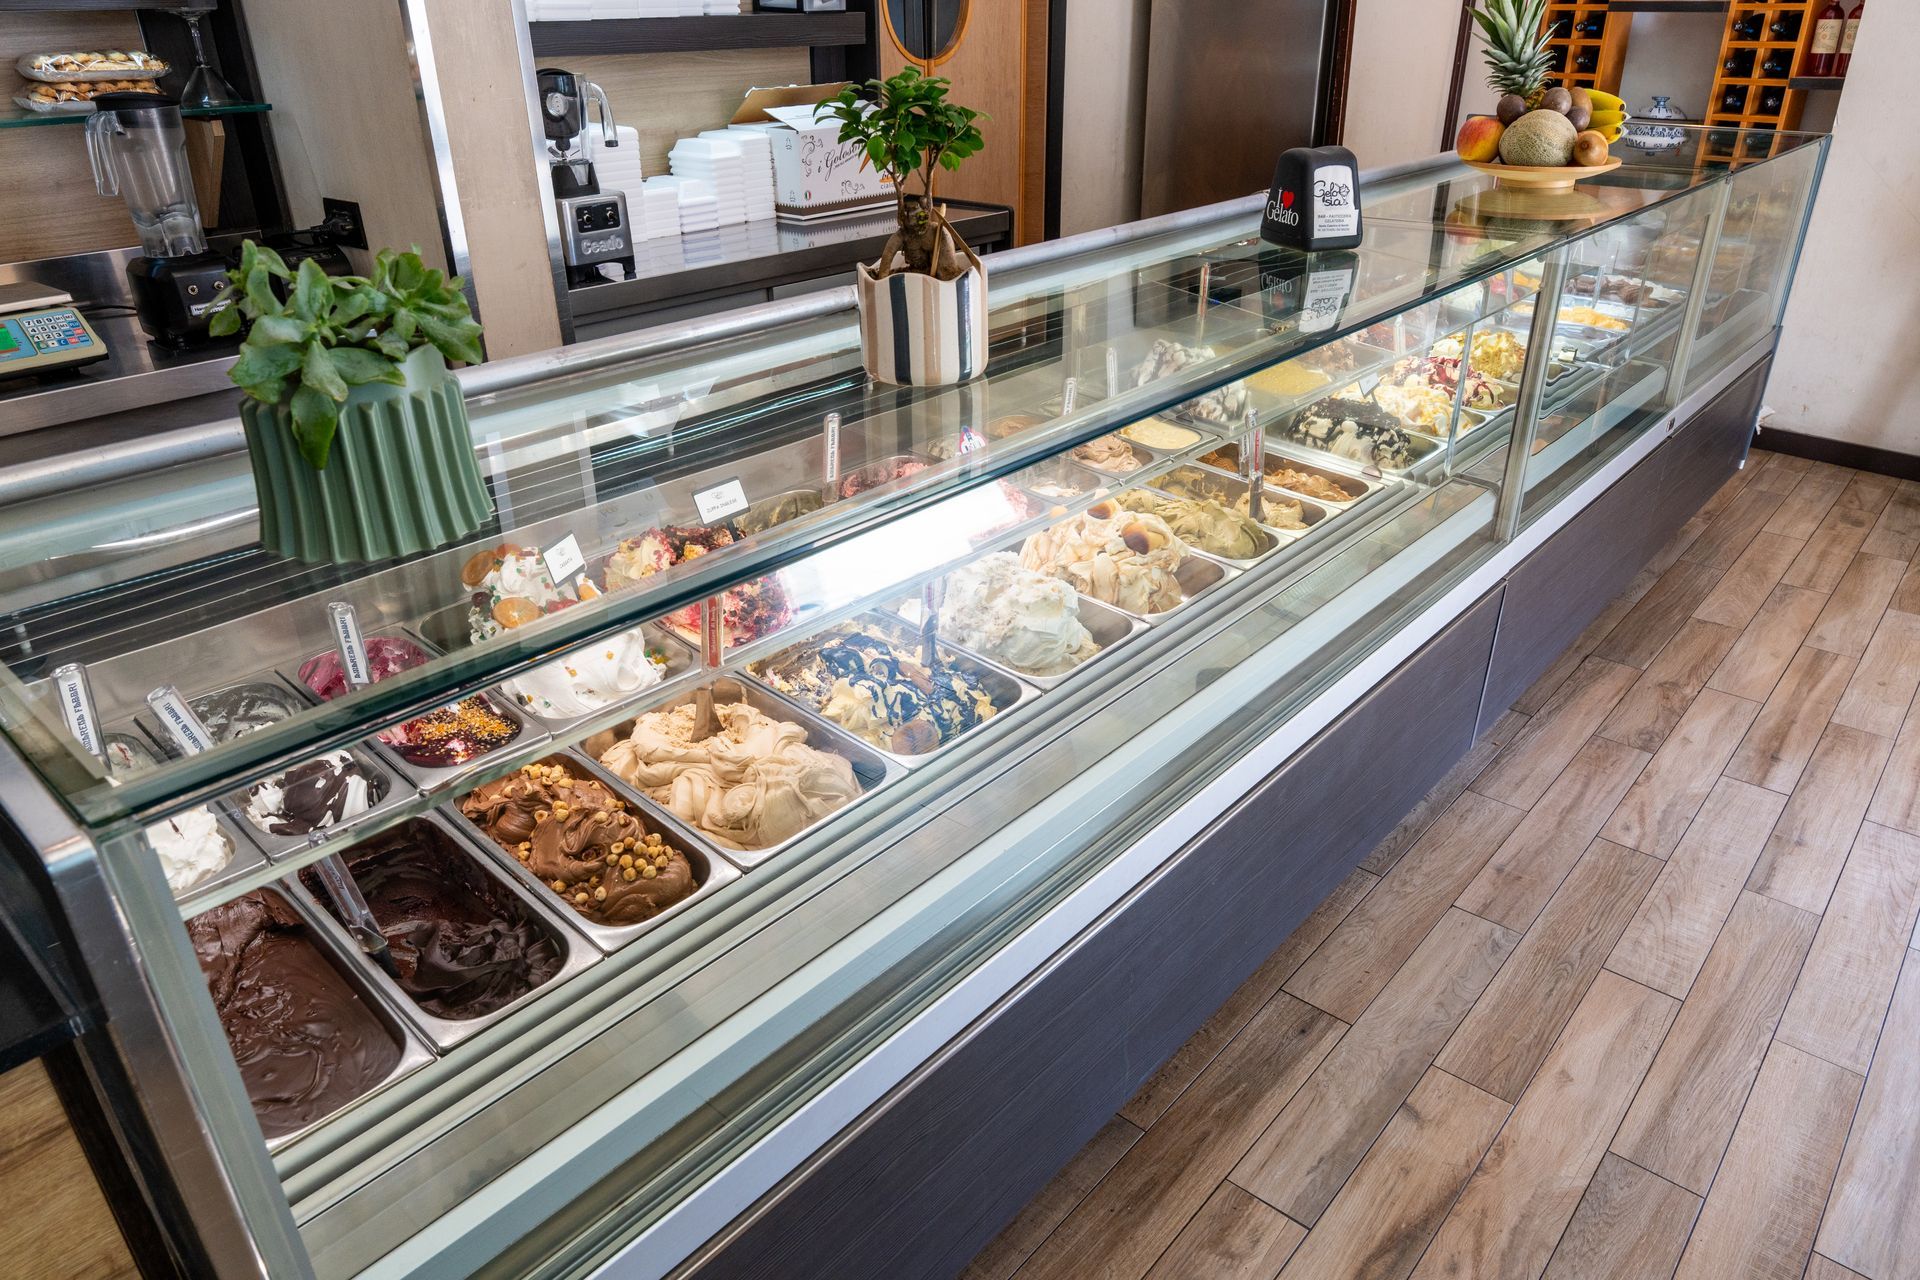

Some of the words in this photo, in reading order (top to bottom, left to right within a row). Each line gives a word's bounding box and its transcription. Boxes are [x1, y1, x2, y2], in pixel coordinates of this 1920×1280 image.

[1266, 200, 1299, 226] Gelato
[581, 235, 623, 255] Ceado
[339, 616, 352, 643] FABBRI
[347, 645, 360, 678] AMARENA
[67, 682, 83, 713] FABBRI
[163, 702, 184, 728] FABBRI
